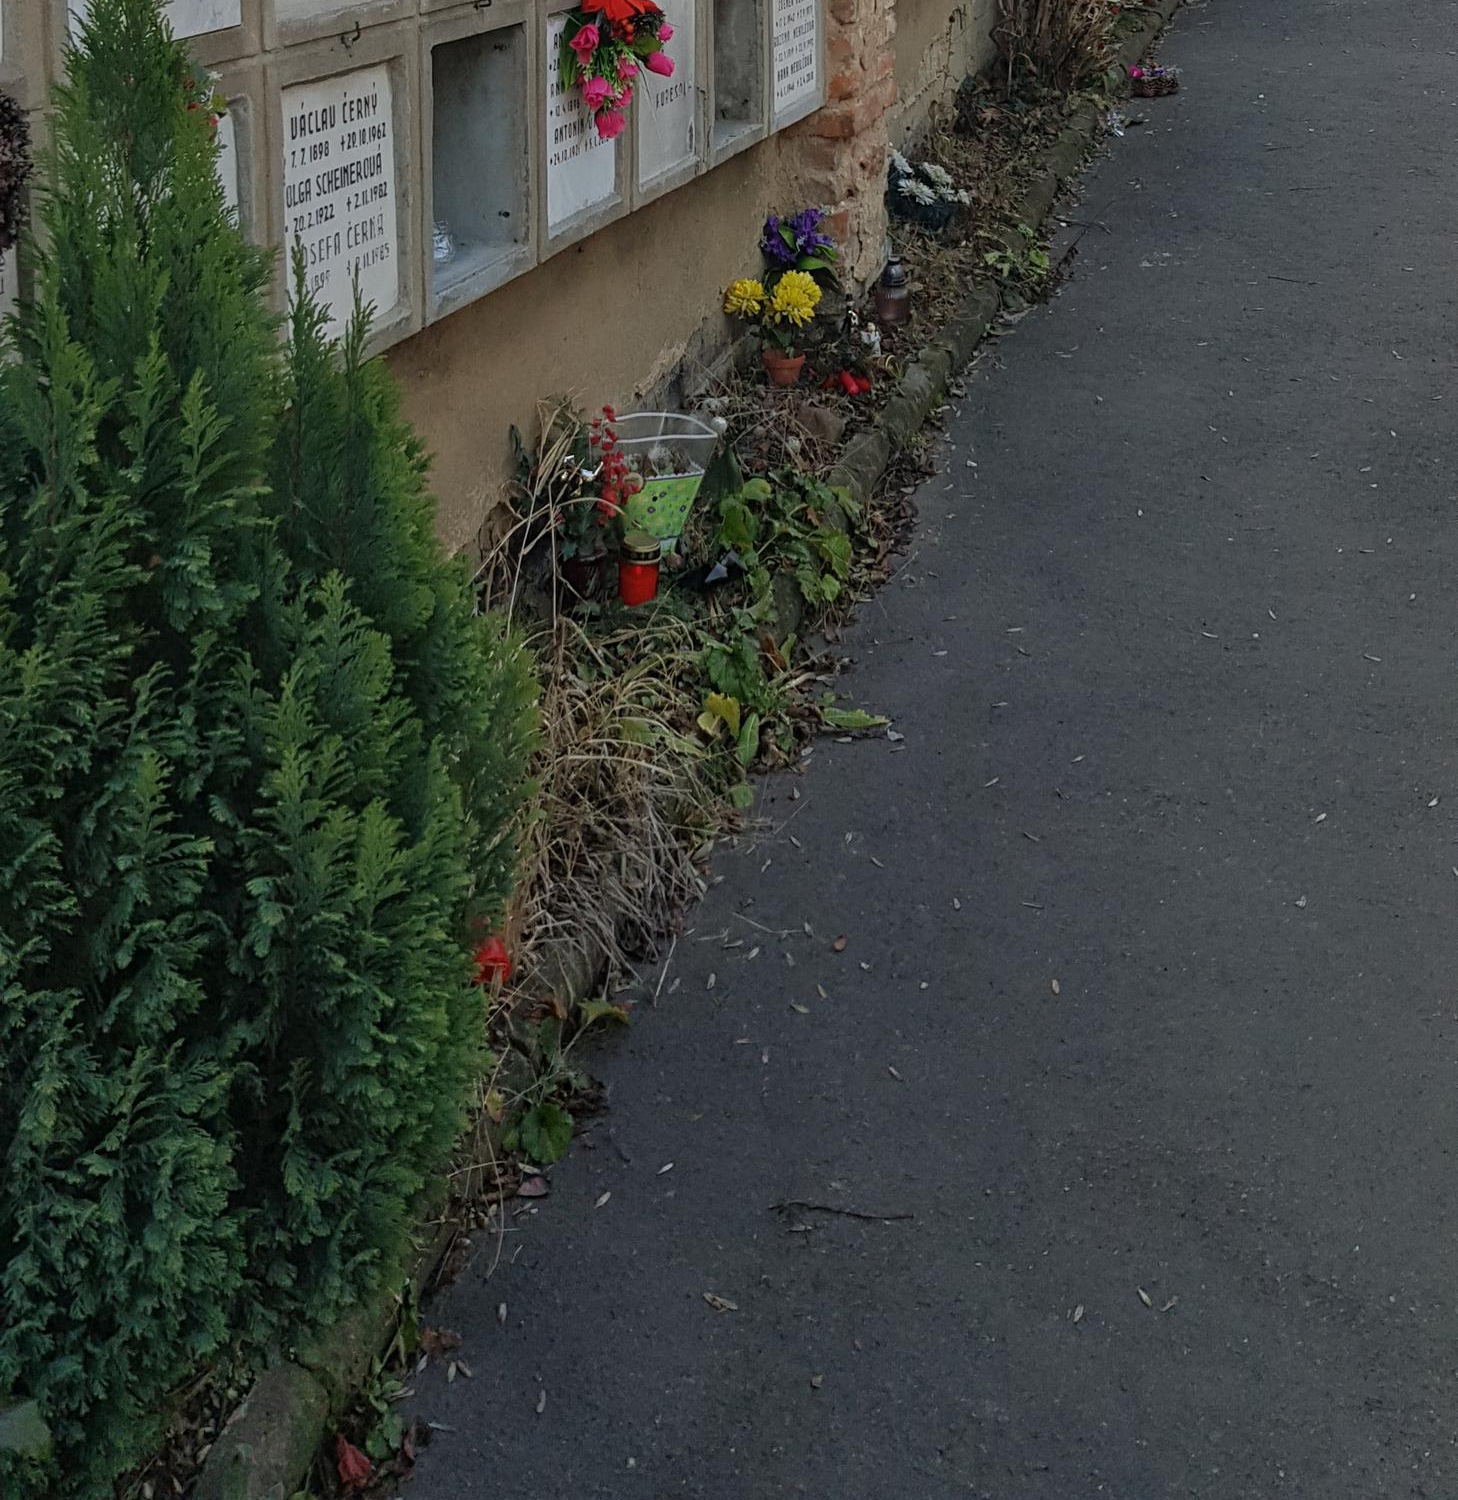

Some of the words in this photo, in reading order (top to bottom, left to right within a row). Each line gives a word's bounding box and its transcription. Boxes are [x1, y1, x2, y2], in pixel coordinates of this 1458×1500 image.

[342, 82, 378, 124] ČERNÝ
[286, 177, 312, 208] OLGA
[301, 231, 341, 269] OSEFA
